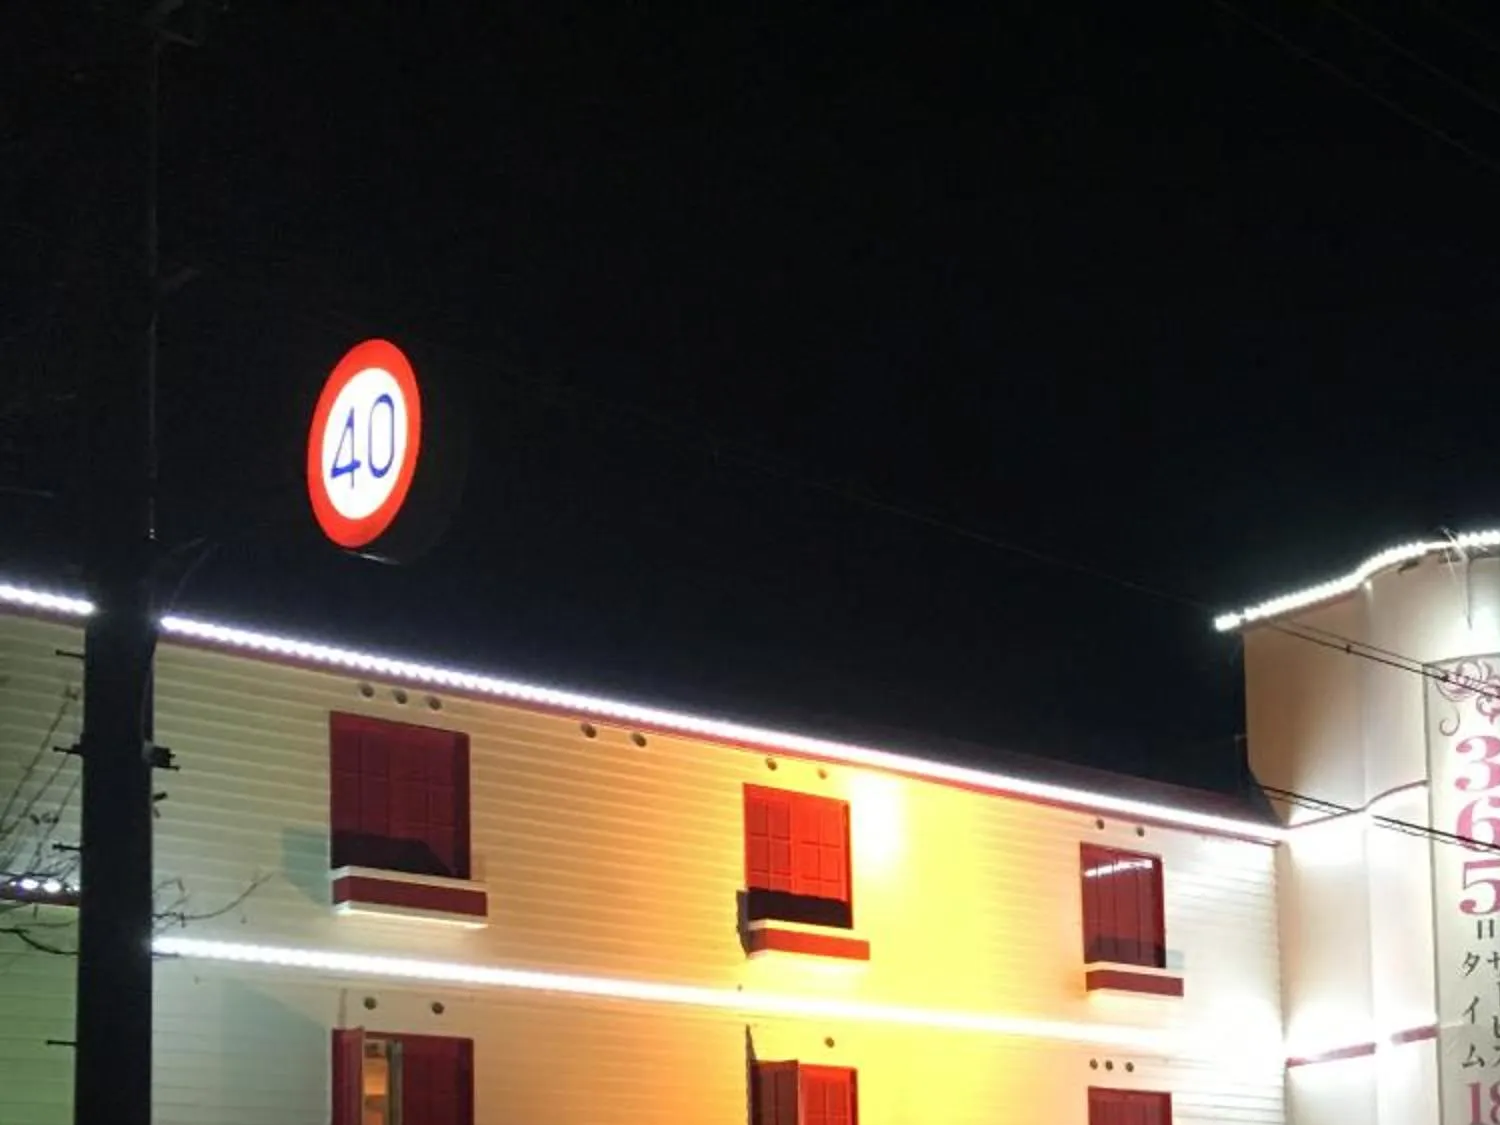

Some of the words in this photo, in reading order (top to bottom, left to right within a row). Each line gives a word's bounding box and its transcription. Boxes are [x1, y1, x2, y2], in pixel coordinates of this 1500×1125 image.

[330, 393, 395, 489] 40
[1461, 951, 1485, 1069] タイム
